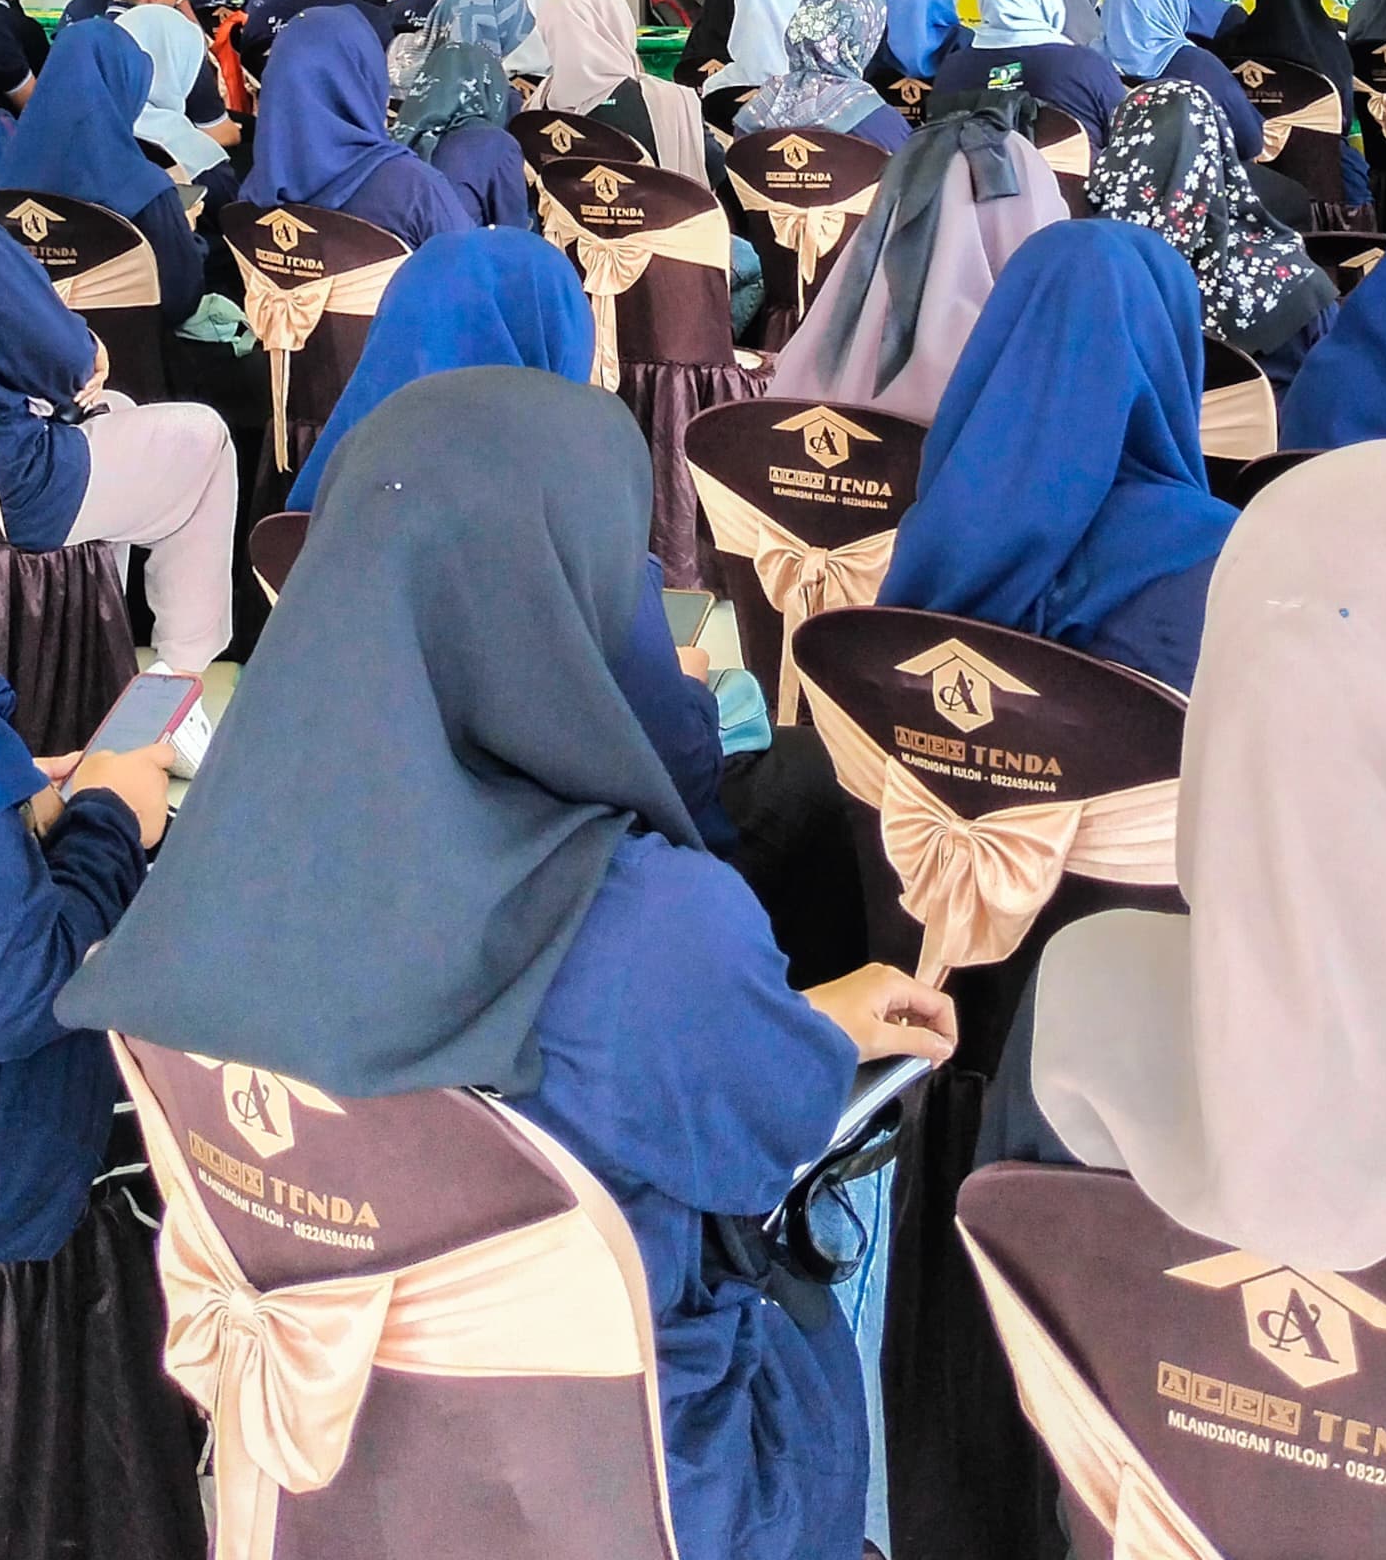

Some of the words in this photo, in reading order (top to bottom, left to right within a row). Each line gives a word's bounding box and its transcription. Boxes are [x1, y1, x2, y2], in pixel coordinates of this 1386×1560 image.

[798, 171, 833, 182] TENDA
[609, 206, 646, 219] TENDA
[37, 246, 79, 258] TENDA
[285, 255, 325, 271] TENDA
[828, 475, 894, 497] TENDA
[971, 744, 1063, 777] TENDA
[952, 765, 982, 783] KULON
[268, 1176, 381, 1230] TENDA
[251, 1202, 285, 1229] KULON
[1274, 1439, 1329, 1471] KULON
